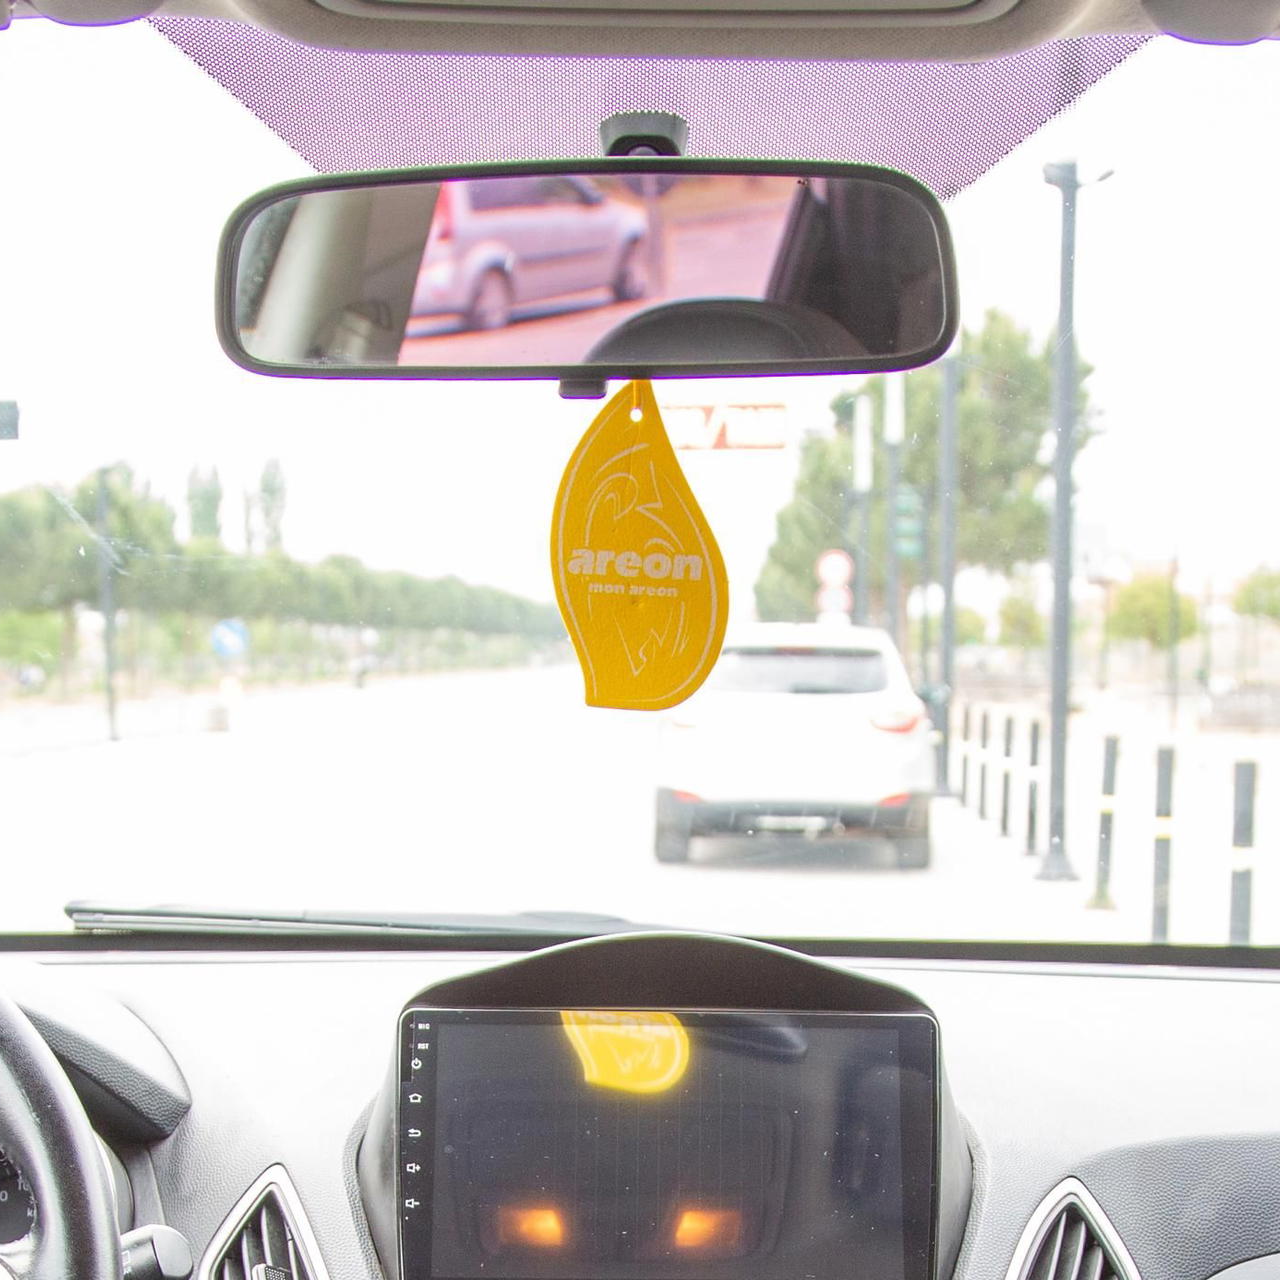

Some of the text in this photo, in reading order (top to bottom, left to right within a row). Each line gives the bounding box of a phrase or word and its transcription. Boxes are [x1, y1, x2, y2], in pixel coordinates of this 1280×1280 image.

[568, 549, 703, 581] areon
[588, 582, 680, 598] mon areon
